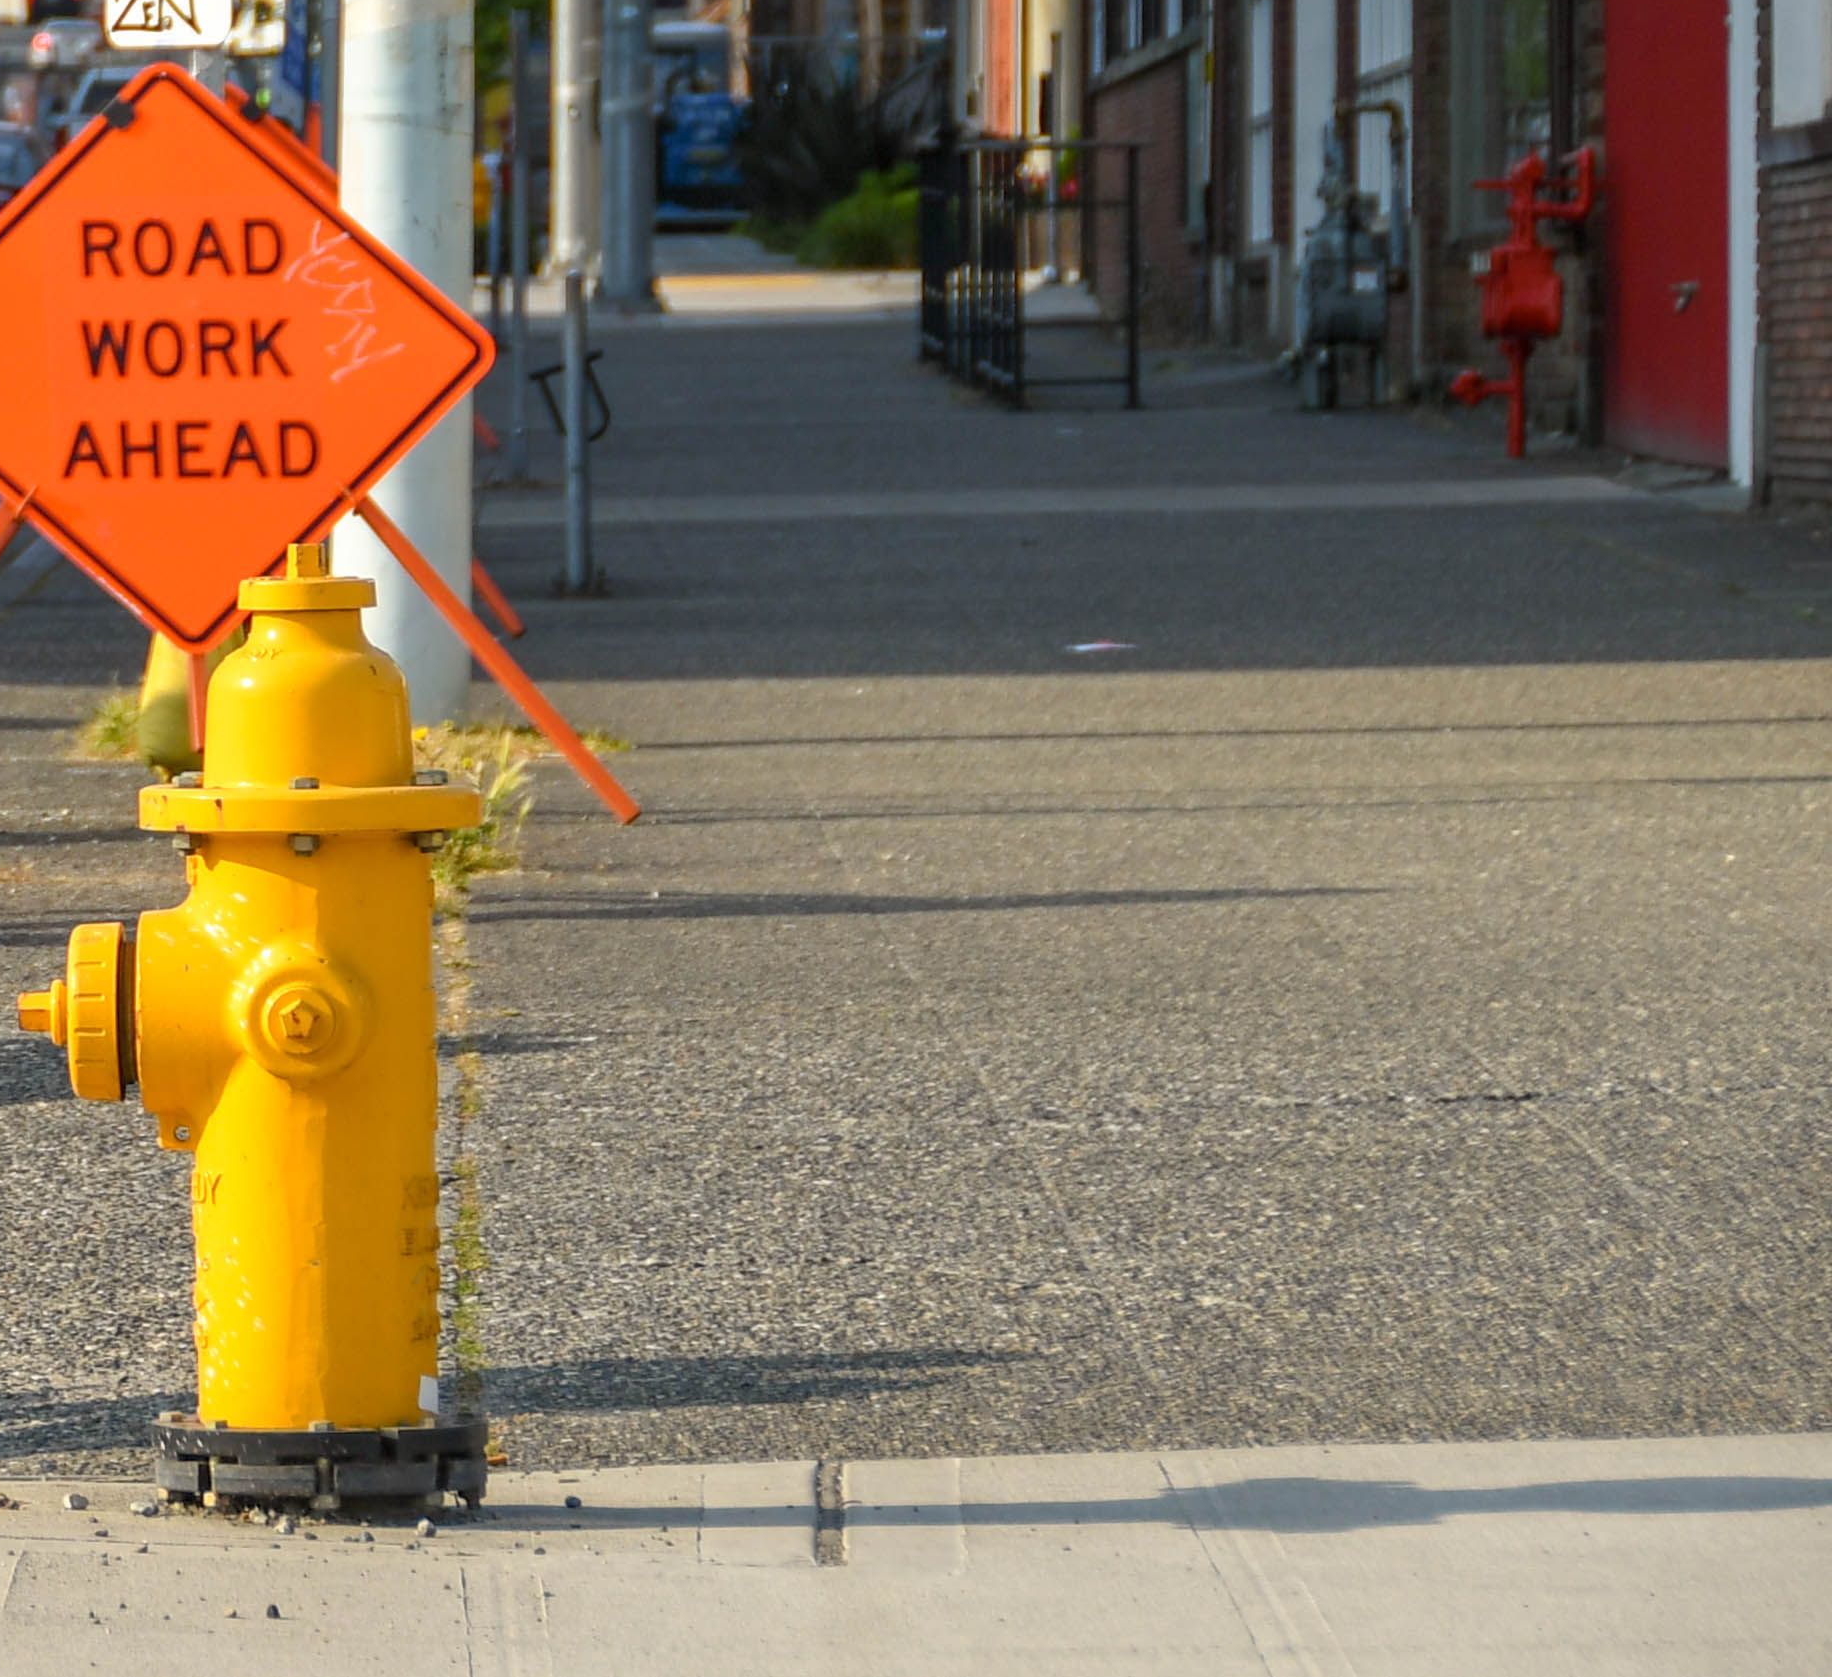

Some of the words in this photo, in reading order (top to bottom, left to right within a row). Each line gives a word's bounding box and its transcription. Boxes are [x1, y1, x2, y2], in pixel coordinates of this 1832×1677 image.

[81, 218, 285, 278] ROAD
[81, 318, 293, 379] WORK
[62, 420, 321, 479] AHEAD
